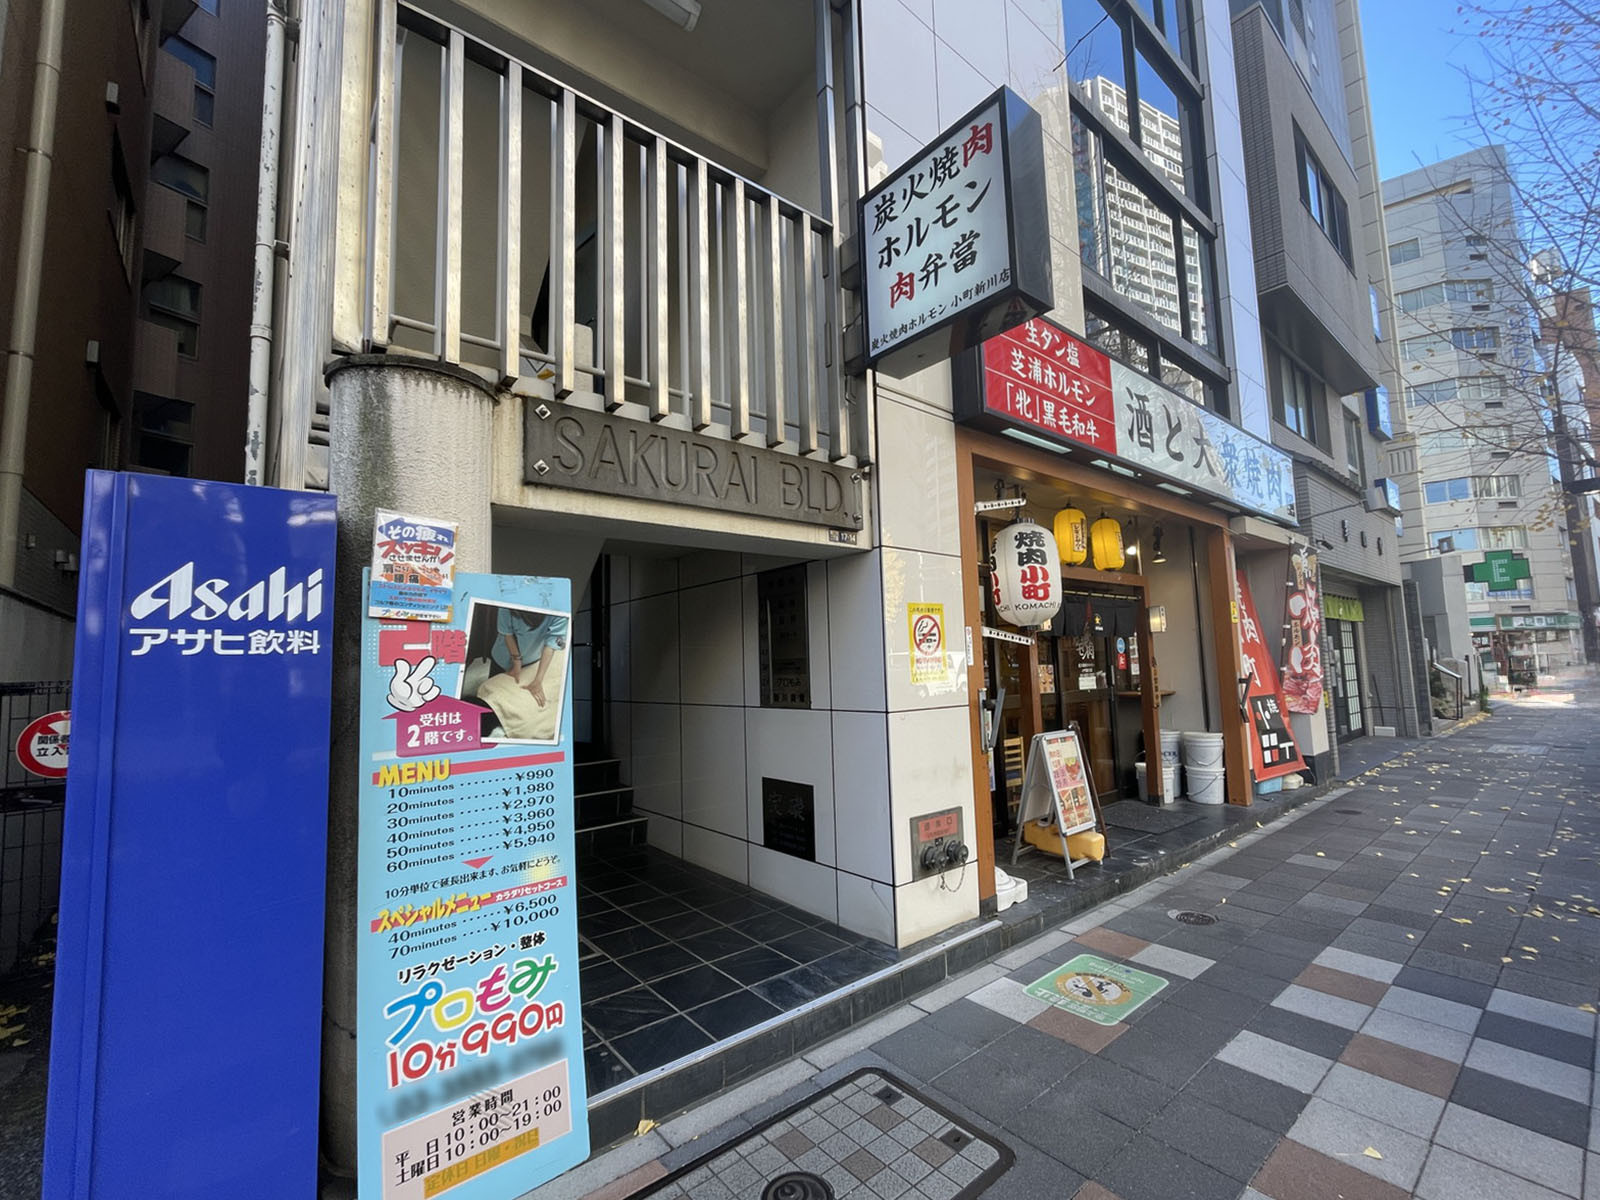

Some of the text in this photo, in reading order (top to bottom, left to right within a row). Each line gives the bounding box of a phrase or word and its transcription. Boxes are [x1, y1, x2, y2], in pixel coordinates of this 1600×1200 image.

[872, 122, 993, 235] 炭火焼肉
[878, 177, 992, 269] ホルモン
[871, 268, 1011, 351] 炭火焼肉ホルモン 小町新川店
[1023, 320, 1081, 369] 生タン塩
[1010, 348, 1096, 407] 芝浦ホルモン
[552, 416, 849, 518] SAKURAI BLD.
[1125, 387, 1282, 503] 酒と大衆焼肉
[377, 540, 454, 564] スッキリ
[388, 525, 449, 542] その疲れ
[1014, 530, 1051, 601] 焼肉小町
[130, 561, 323, 622] Asahi
[129, 628, 320, 656] アサヒ飲料
[407, 724, 473, 748] 2階です。
[419, 711, 462, 729] 受付は
[36, 746, 69, 757] 立入
[378, 758, 451, 788] MENU
[386, 781, 555, 815] 20minutes ¥1,980
[388, 768, 554, 800] 10minutes ¥990
[386, 794, 555, 829] 30minutes ¥2,970
[386, 807, 555, 844] 40minutes ¥3,960
[386, 820, 555, 859] 50minutes ¥4,950
[386, 832, 555, 873] 60minutes ¥5,940
[377, 879, 563, 934] スペシャルメニュー カラダリセットコース
[388, 894, 557, 944] 40minutes ¥6,500
[388, 906, 559, 960] 70minutes ¥10,000
[398, 931, 546, 984] リラクゼーション・整体
[385, 955, 558, 1046] プロもみ
[388, 1002, 565, 1088] 10分990円
[451, 1088, 514, 1127] 営業時間
[395, 1153, 440, 1187] 土曜日
